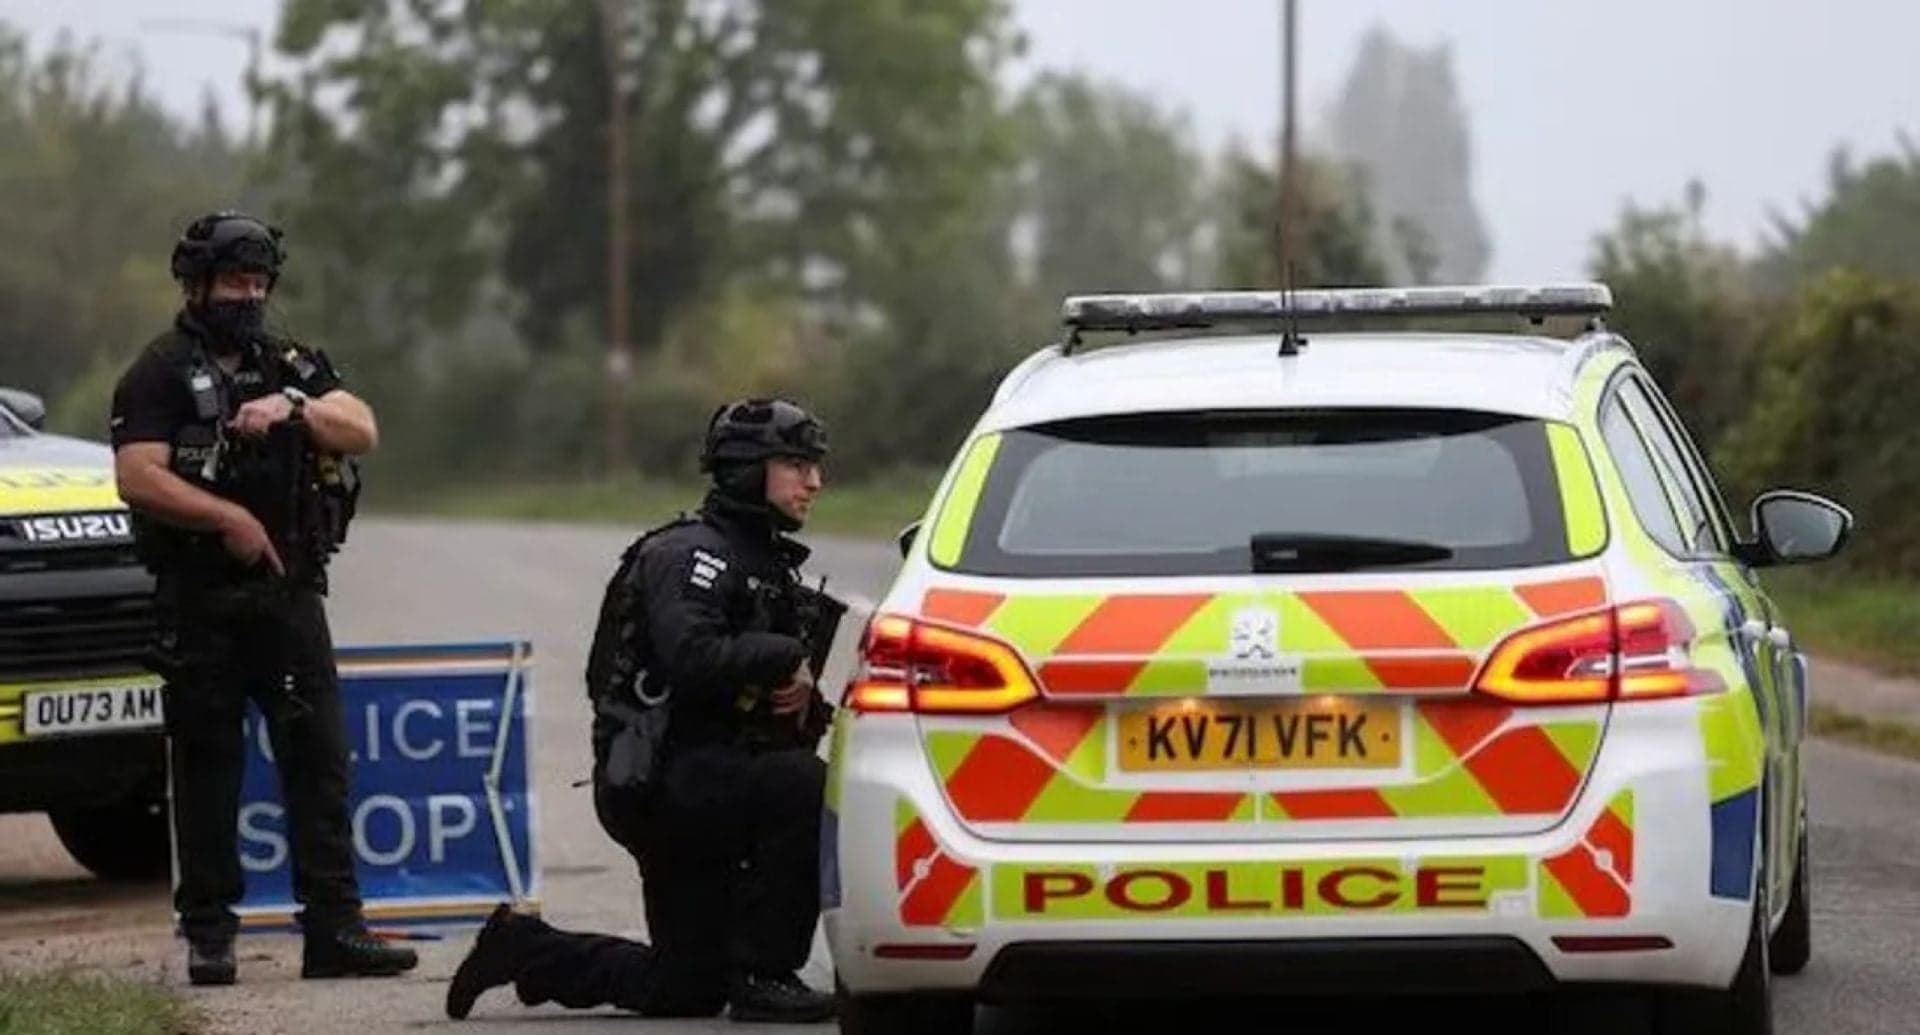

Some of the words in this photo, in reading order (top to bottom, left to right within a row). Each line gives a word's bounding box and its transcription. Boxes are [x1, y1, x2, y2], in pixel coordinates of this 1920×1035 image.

[23, 514, 130, 541] ISUZU
[38, 692, 113, 726] OU73
[120, 689, 156, 720] AM
[1147, 715, 1255, 761] KV71
[1272, 714, 1367, 760] VFK
[236, 795, 476, 872] SOP
[1022, 866, 1488, 914] POLICE
